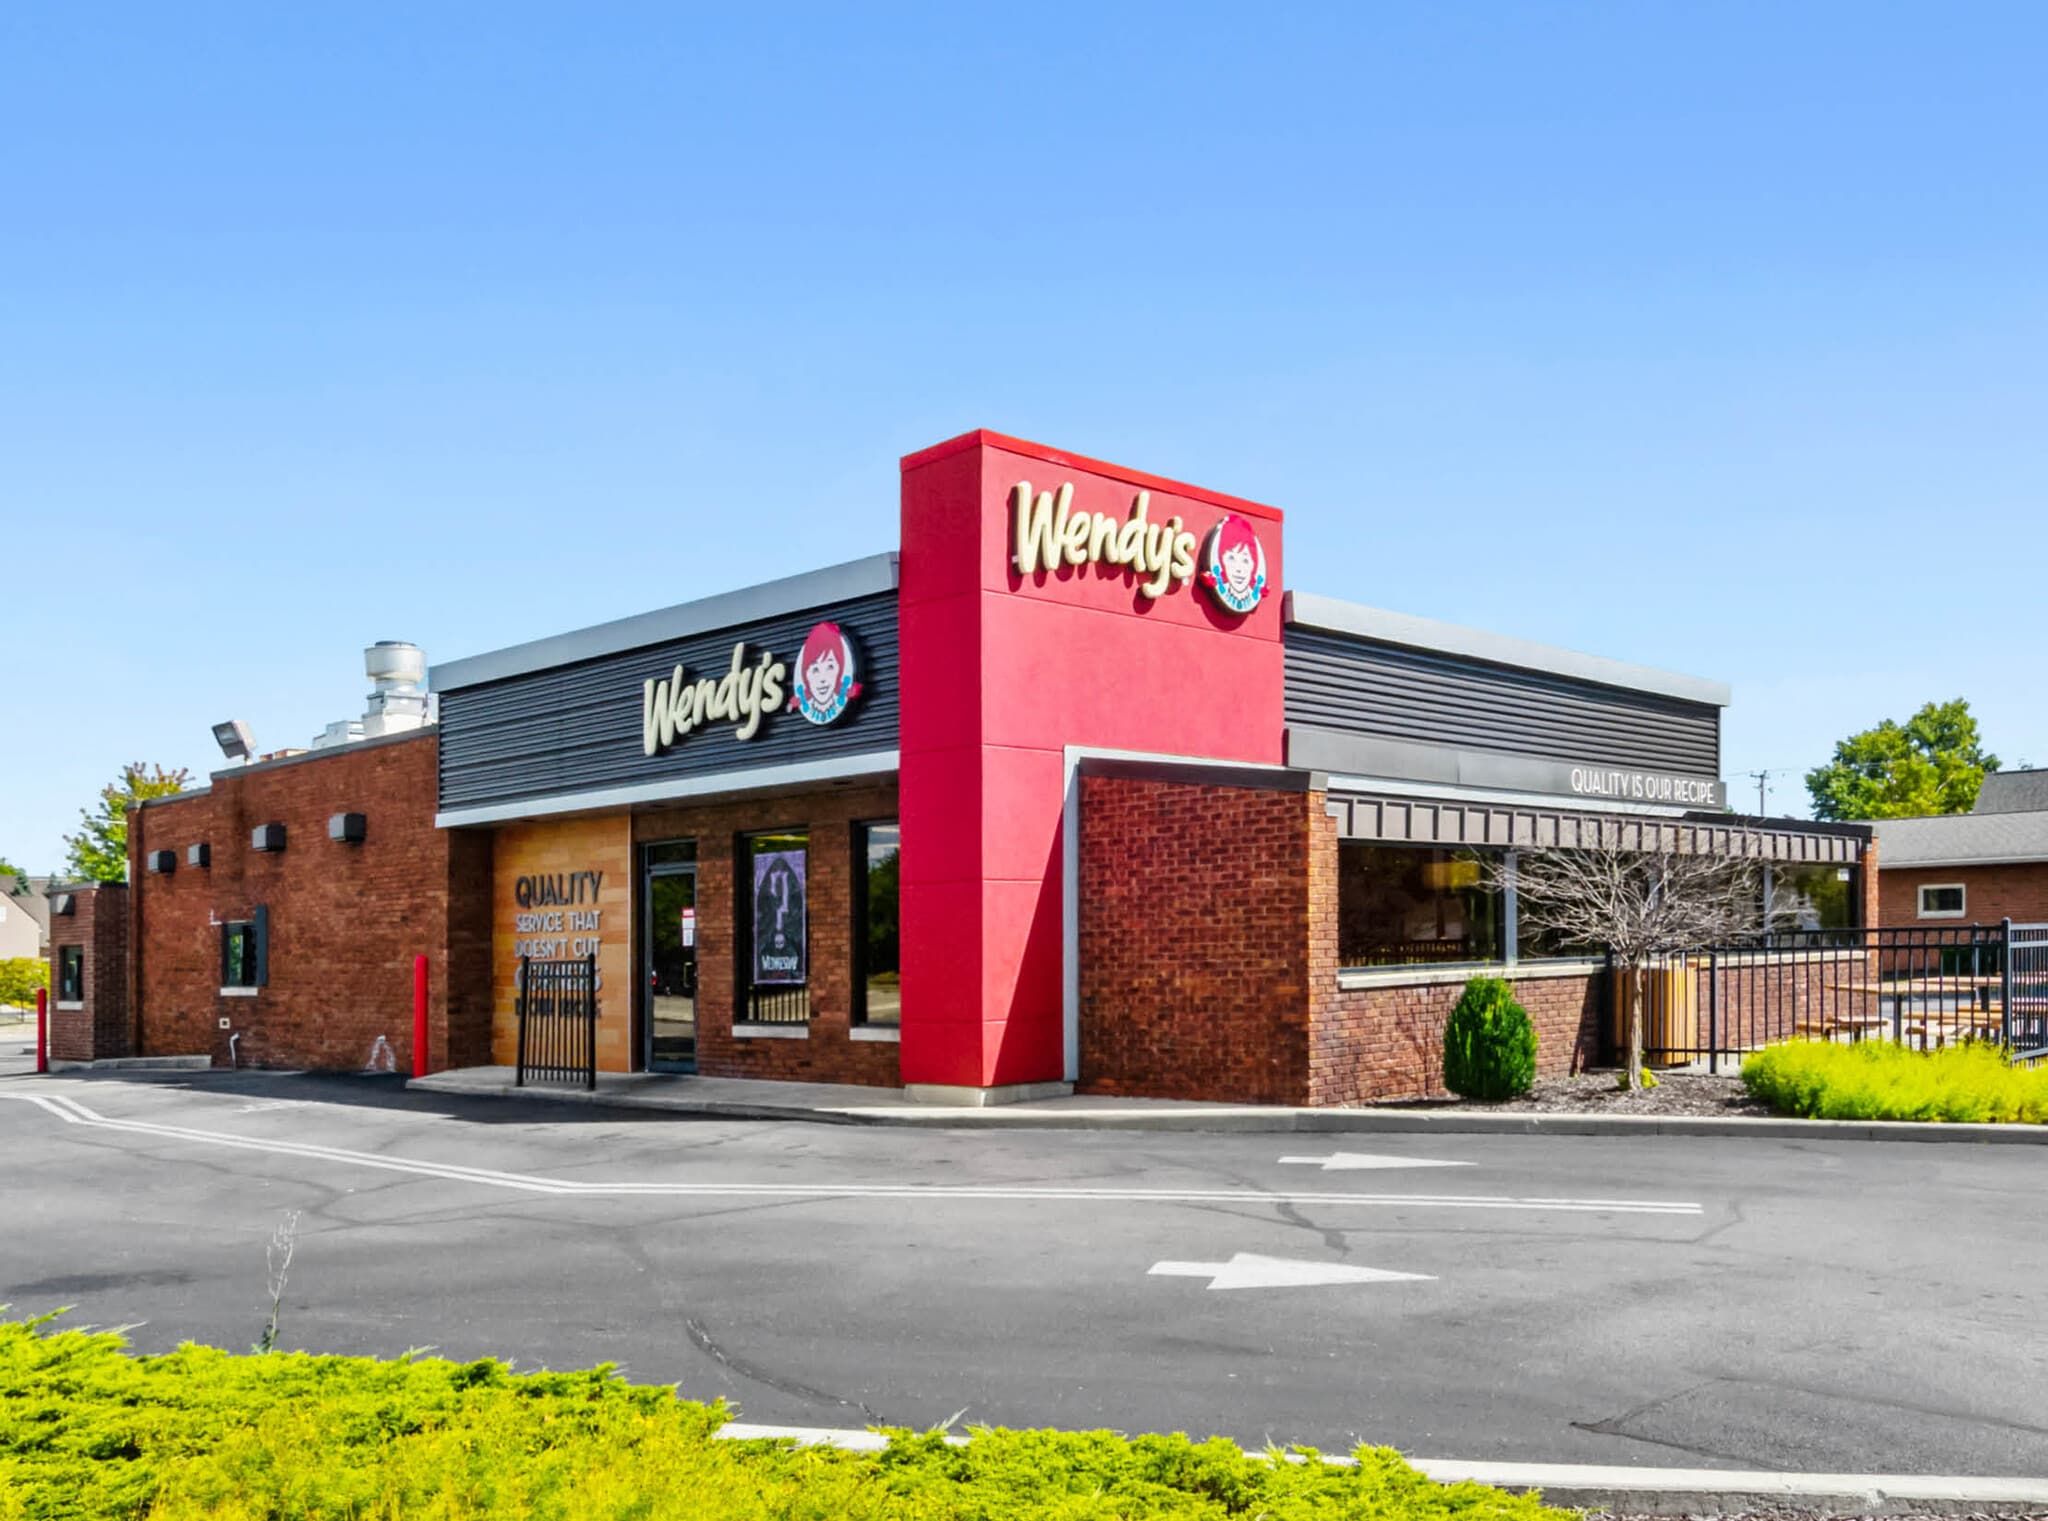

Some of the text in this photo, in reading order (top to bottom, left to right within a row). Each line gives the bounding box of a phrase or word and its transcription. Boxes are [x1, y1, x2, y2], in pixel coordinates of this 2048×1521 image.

[1017, 481, 1196, 598] Wendy's
[643, 641, 786, 756] Wendy's
[1571, 768, 1716, 804] QUALITY IS OUR RECIPE
[515, 871, 603, 909] QUALITY
[515, 910, 601, 933] SERVICE THAT
[514, 936, 601, 959] DOESN'T CUT
